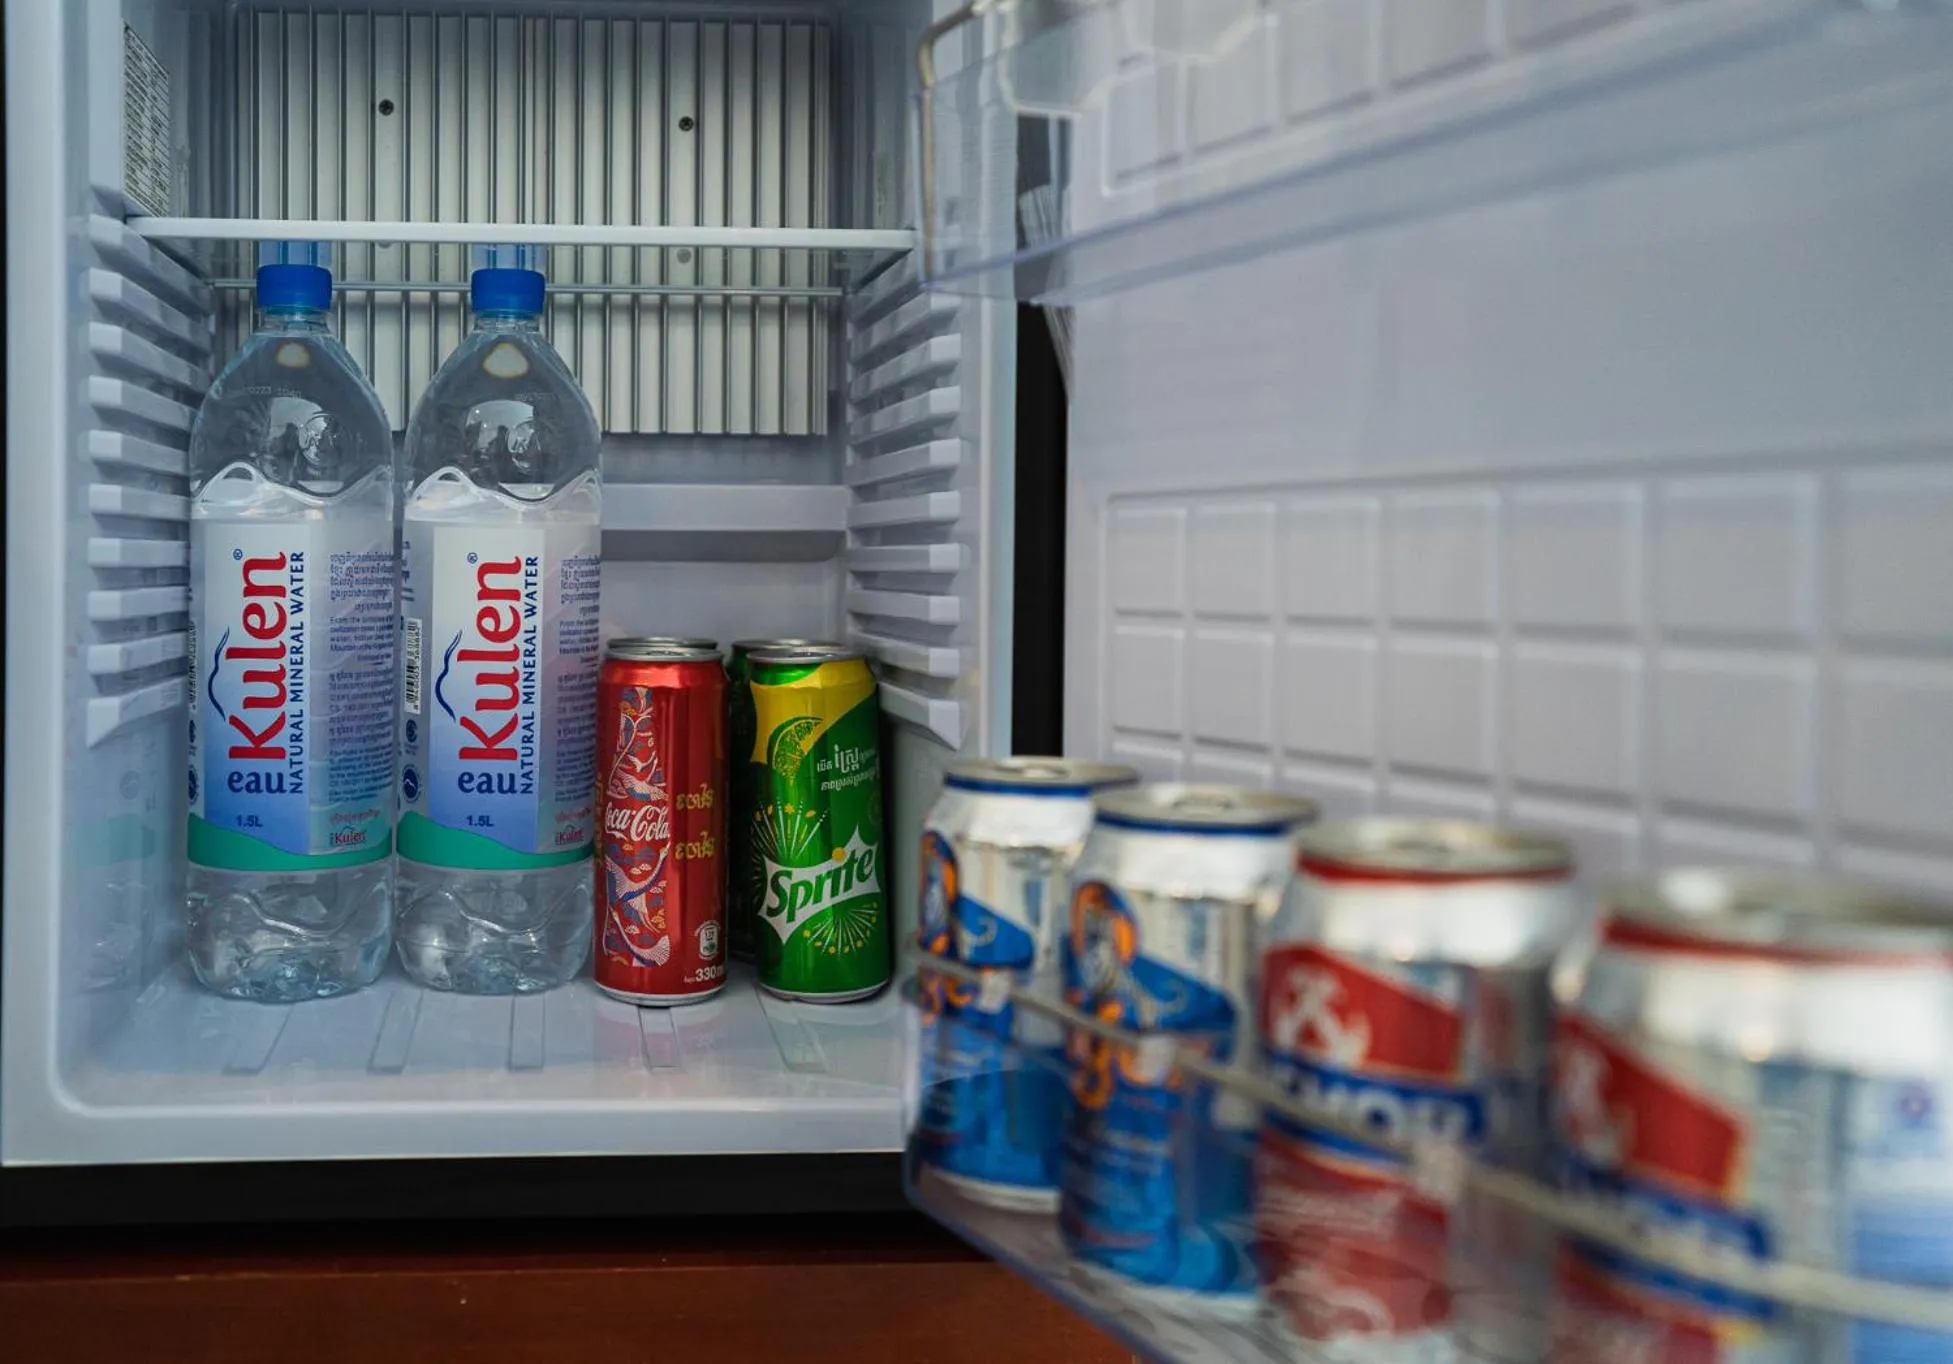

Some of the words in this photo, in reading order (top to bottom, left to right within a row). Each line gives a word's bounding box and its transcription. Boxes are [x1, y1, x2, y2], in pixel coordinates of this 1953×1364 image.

[290, 552, 304, 615] WATER
[524, 556, 538, 619] WATER
[225, 551, 287, 759] Kulen
[289, 621, 304, 702] MINERAL
[457, 556, 521, 760] Kulen
[522, 625, 537, 705] MINERAL
[227, 771, 287, 794] eau
[289, 709, 304, 793] NATURAL
[457, 771, 517, 794] eau
[520, 711, 535, 794] NATURAL
[236, 814, 263, 827] 1.5L
[467, 815, 494, 827] 1.5L
[766, 848, 873, 924] Sprite
